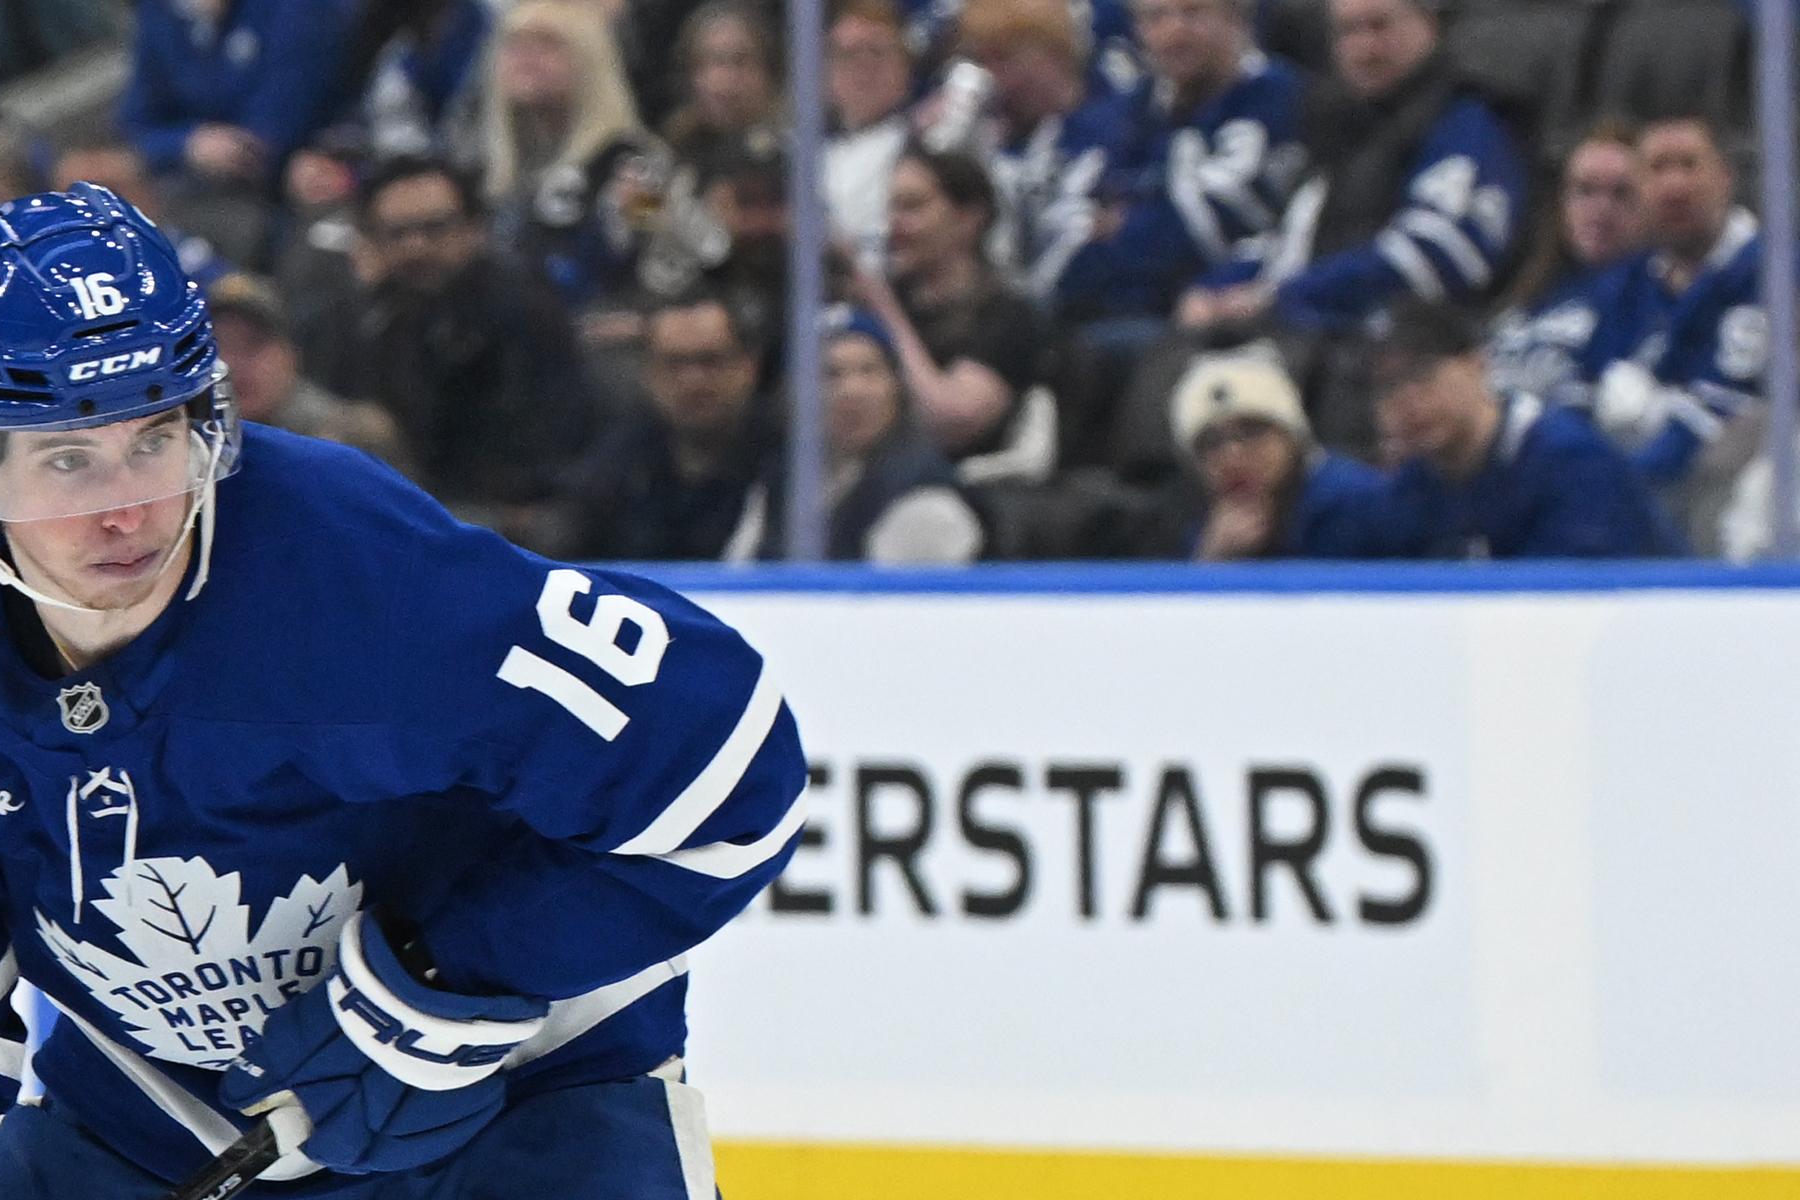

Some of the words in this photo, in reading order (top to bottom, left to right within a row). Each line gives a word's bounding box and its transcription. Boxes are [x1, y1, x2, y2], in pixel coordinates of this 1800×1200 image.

[69, 272, 124, 320] 16
[68, 347, 162, 381] CCM
[496, 568, 670, 742] 16
[109, 946, 324, 1010] TORONTO
